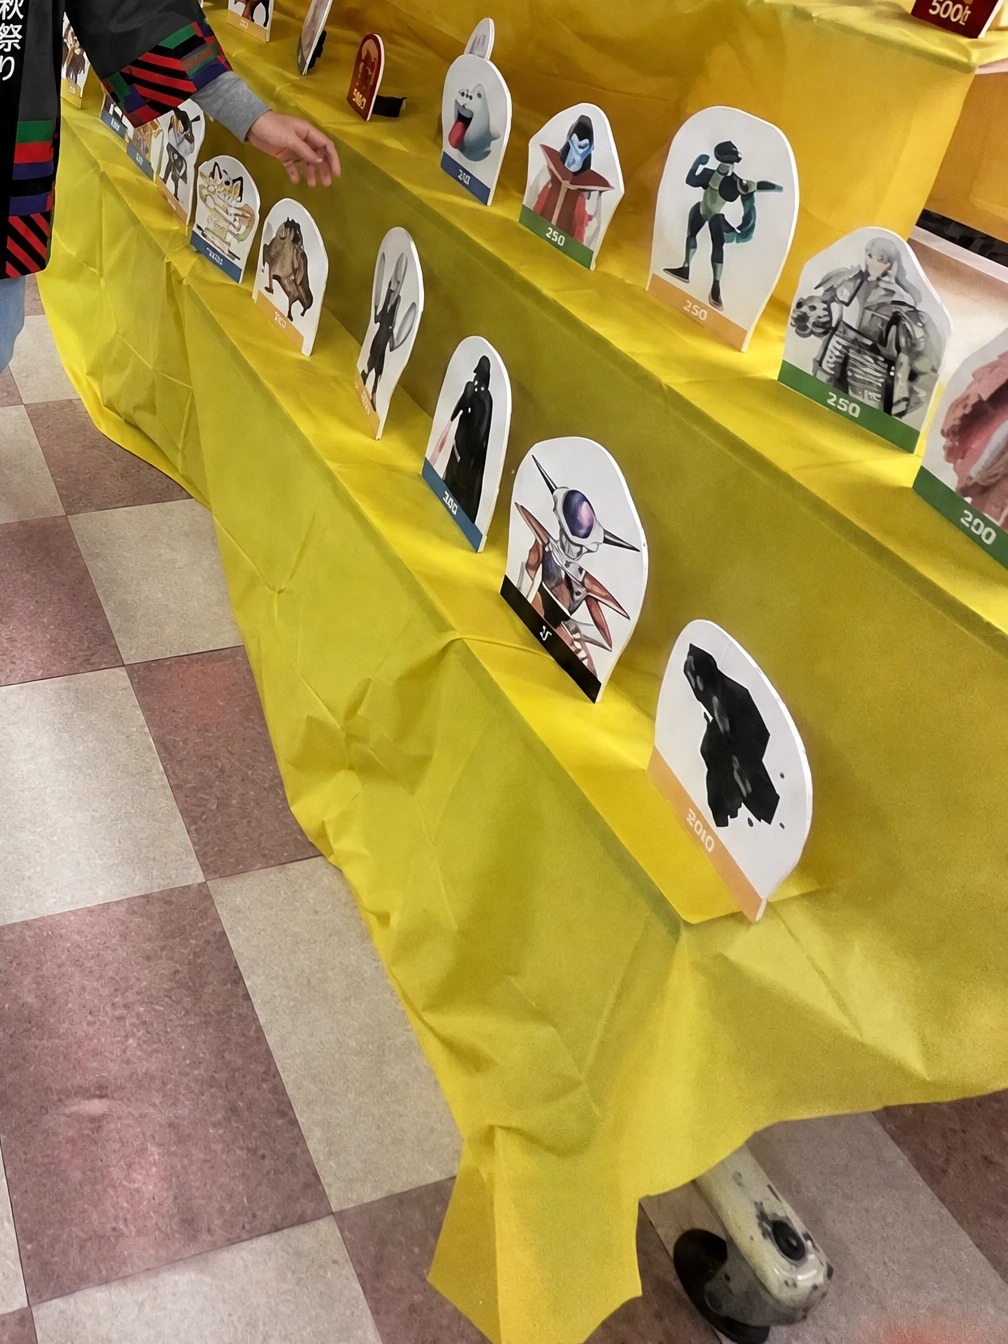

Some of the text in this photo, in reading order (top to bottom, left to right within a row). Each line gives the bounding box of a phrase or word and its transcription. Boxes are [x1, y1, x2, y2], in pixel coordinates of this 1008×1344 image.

[545, 227, 566, 247] 250
[683, 299, 708, 321] 250
[826, 391, 861, 418] 250
[960, 509, 997, 545] 200
